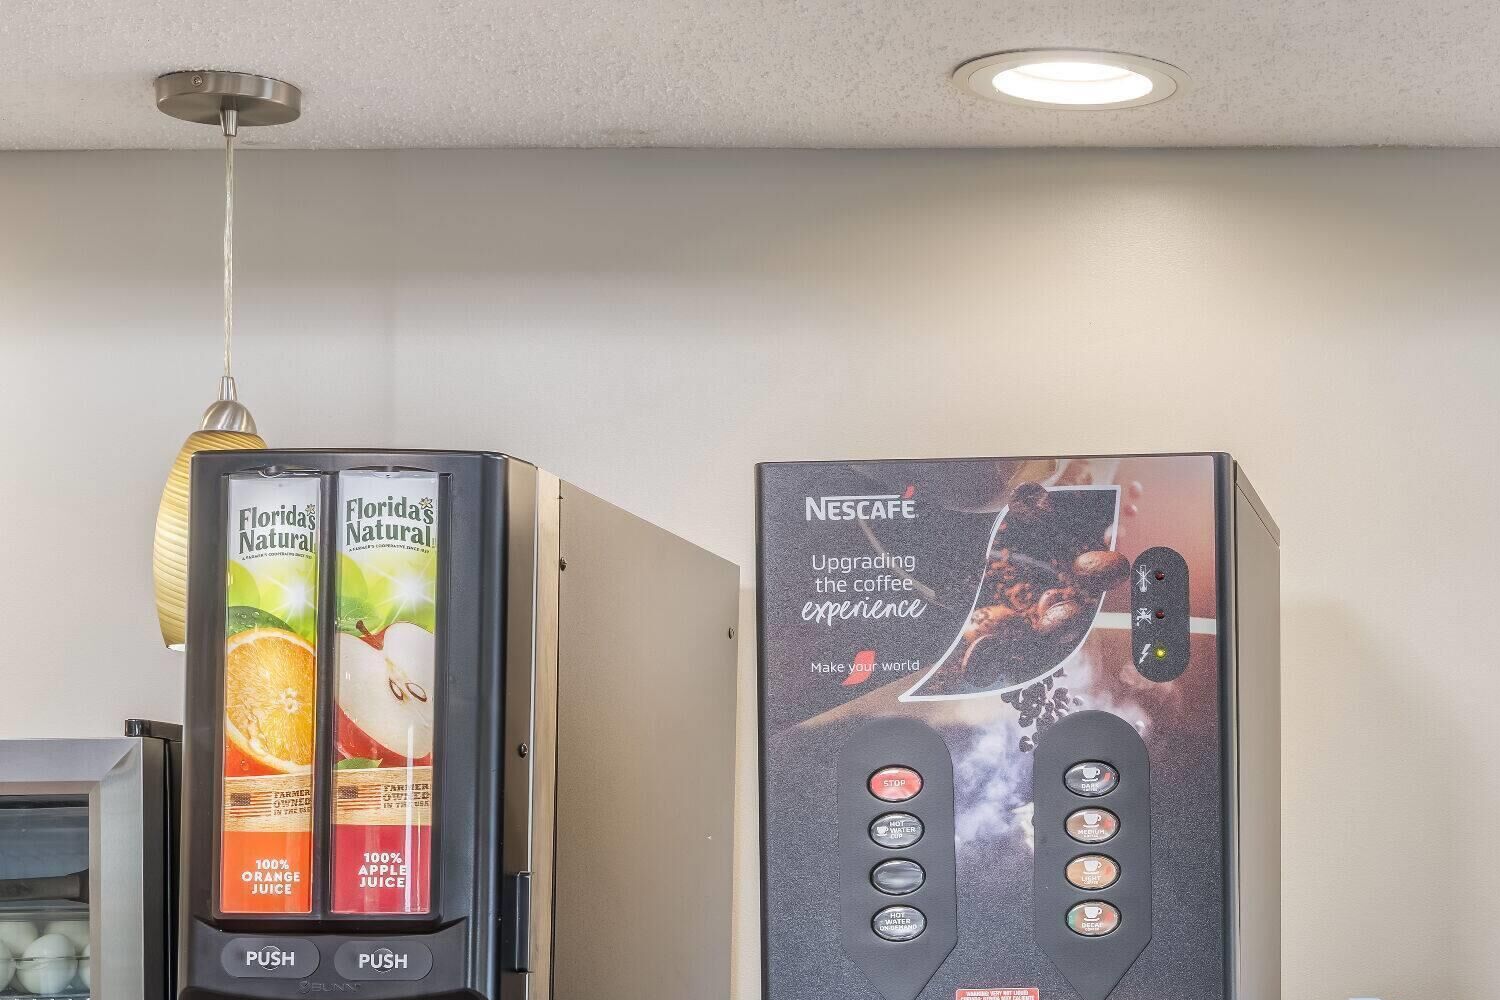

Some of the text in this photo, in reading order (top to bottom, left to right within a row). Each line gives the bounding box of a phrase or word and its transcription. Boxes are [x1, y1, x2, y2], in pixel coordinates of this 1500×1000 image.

[805, 484, 917, 521] NESCAFÉ
[345, 520, 431, 546] Natural
[239, 528, 314, 554] Natural
[812, 553, 916, 573] Upgrading
[815, 574, 913, 593] the coffee
[801, 597, 927, 627] experience
[811, 659, 920, 675] Make your world
[883, 779, 906, 787] STOP
[274, 790, 310, 798] FARMER
[890, 826, 916, 834] WATER
[255, 859, 290, 870] 100%
[363, 852, 402, 864] 100%
[241, 871, 301, 882] ORANGE
[358, 864, 407, 876] APPLE
[359, 876, 405, 888] JUICE
[251, 883, 292, 895] JUICE
[246, 951, 295, 966] PUSH
[358, 953, 408, 969] PUSH
